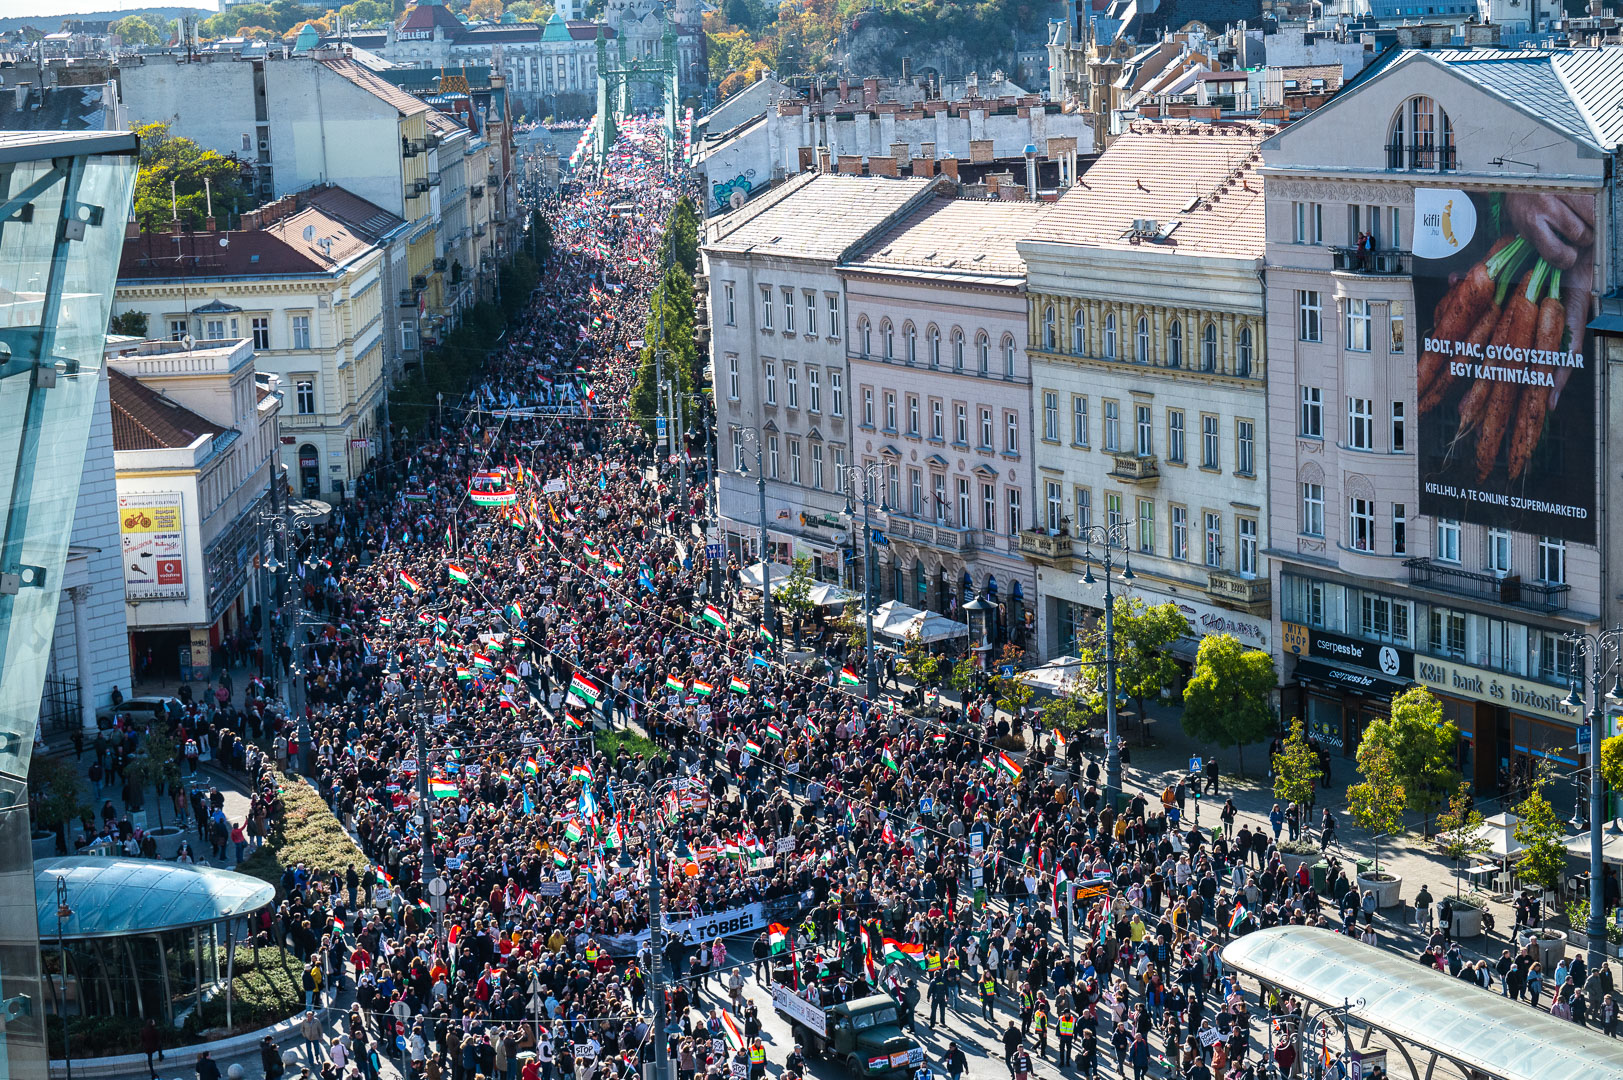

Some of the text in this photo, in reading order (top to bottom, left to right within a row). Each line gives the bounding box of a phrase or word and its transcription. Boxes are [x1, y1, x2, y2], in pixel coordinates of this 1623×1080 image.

[398, 29, 432, 40] GELLÉRT
[1424, 214, 1440, 227] kifli
[1424, 337, 1584, 369] BOLT, PIAC, GYÓGYSZERTÁR
[1450, 362, 1555, 388] EGY KATTINTÁSRA
[1425, 482, 1588, 519] KIFLI.HU, A TE ONLINE SZUPERMARKETED
[1287, 623, 1302, 635] MIX
[1285, 634, 1306, 647] SHOP
[1419, 662, 1446, 684] K&H
[1452, 669, 1483, 694] bank
[1489, 679, 1504, 699] és
[696, 913, 754, 940] TÖBBÉ!
[575, 1045, 593, 1054] STOP
[732, 1064, 746, 1073] STOP
